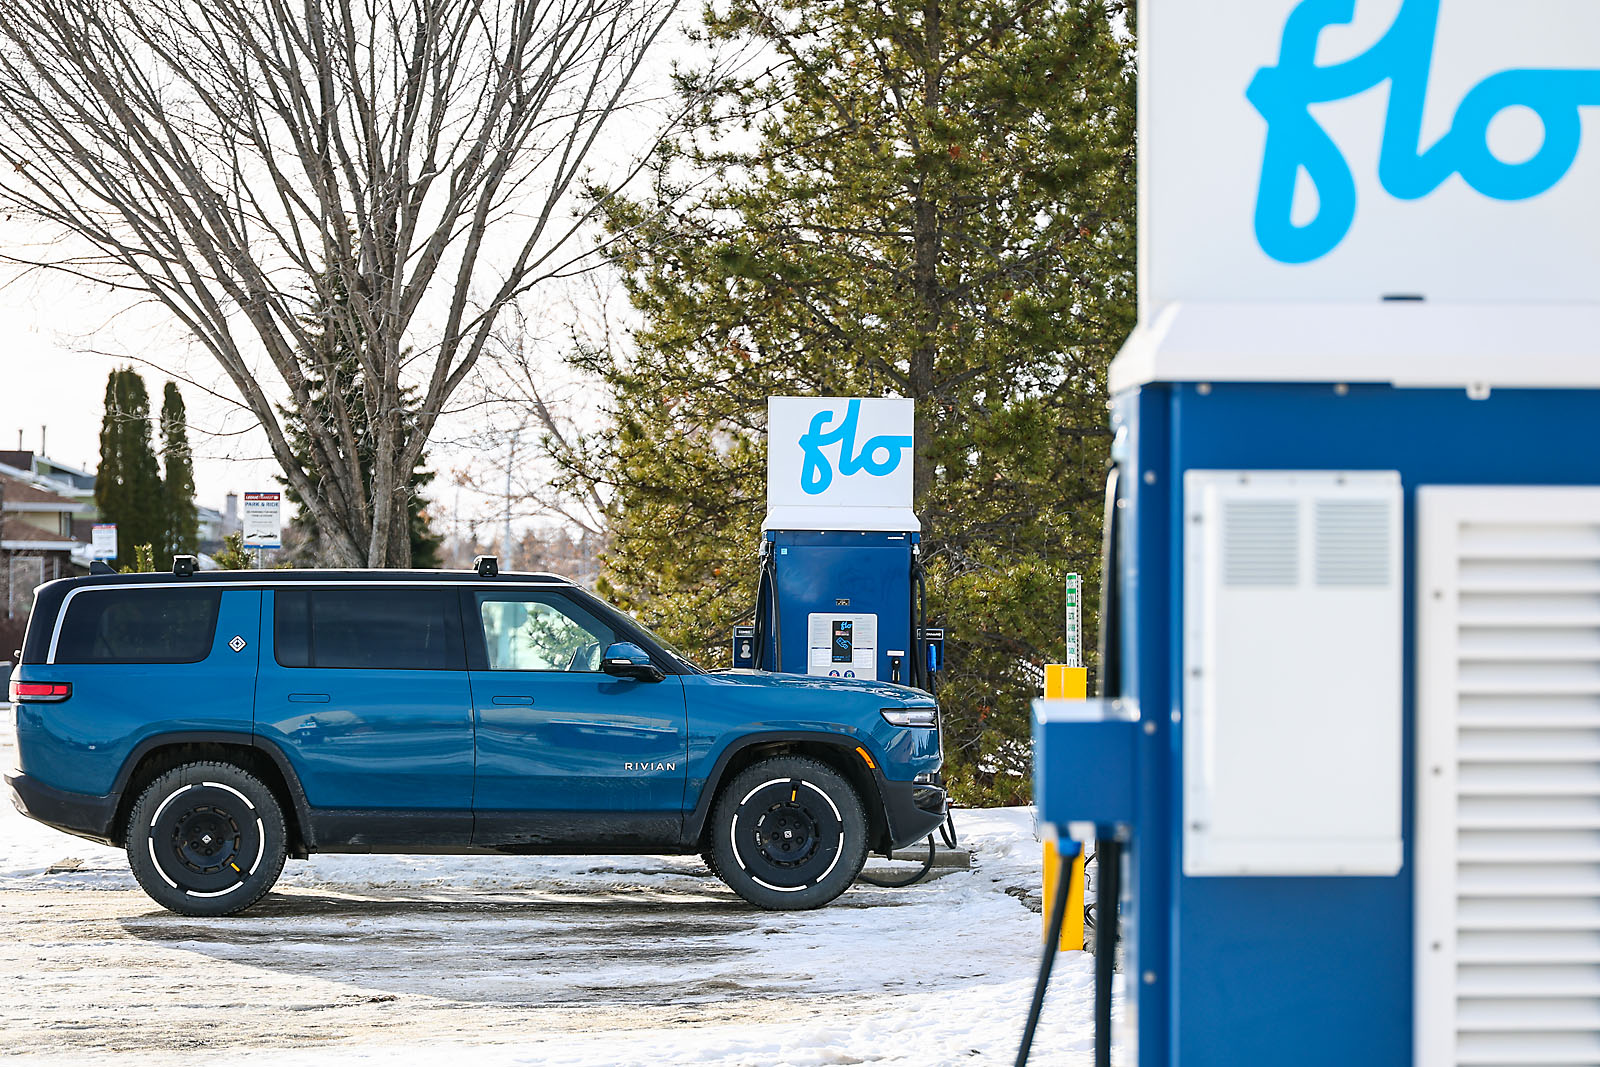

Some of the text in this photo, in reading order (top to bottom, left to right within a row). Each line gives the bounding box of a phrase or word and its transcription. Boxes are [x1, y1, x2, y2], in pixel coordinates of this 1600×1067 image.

[1246, 0, 1600, 264] flo
[798, 399, 912, 495] flo
[841, 622, 852, 630] flo
[625, 762, 675, 771] RIVIAN
